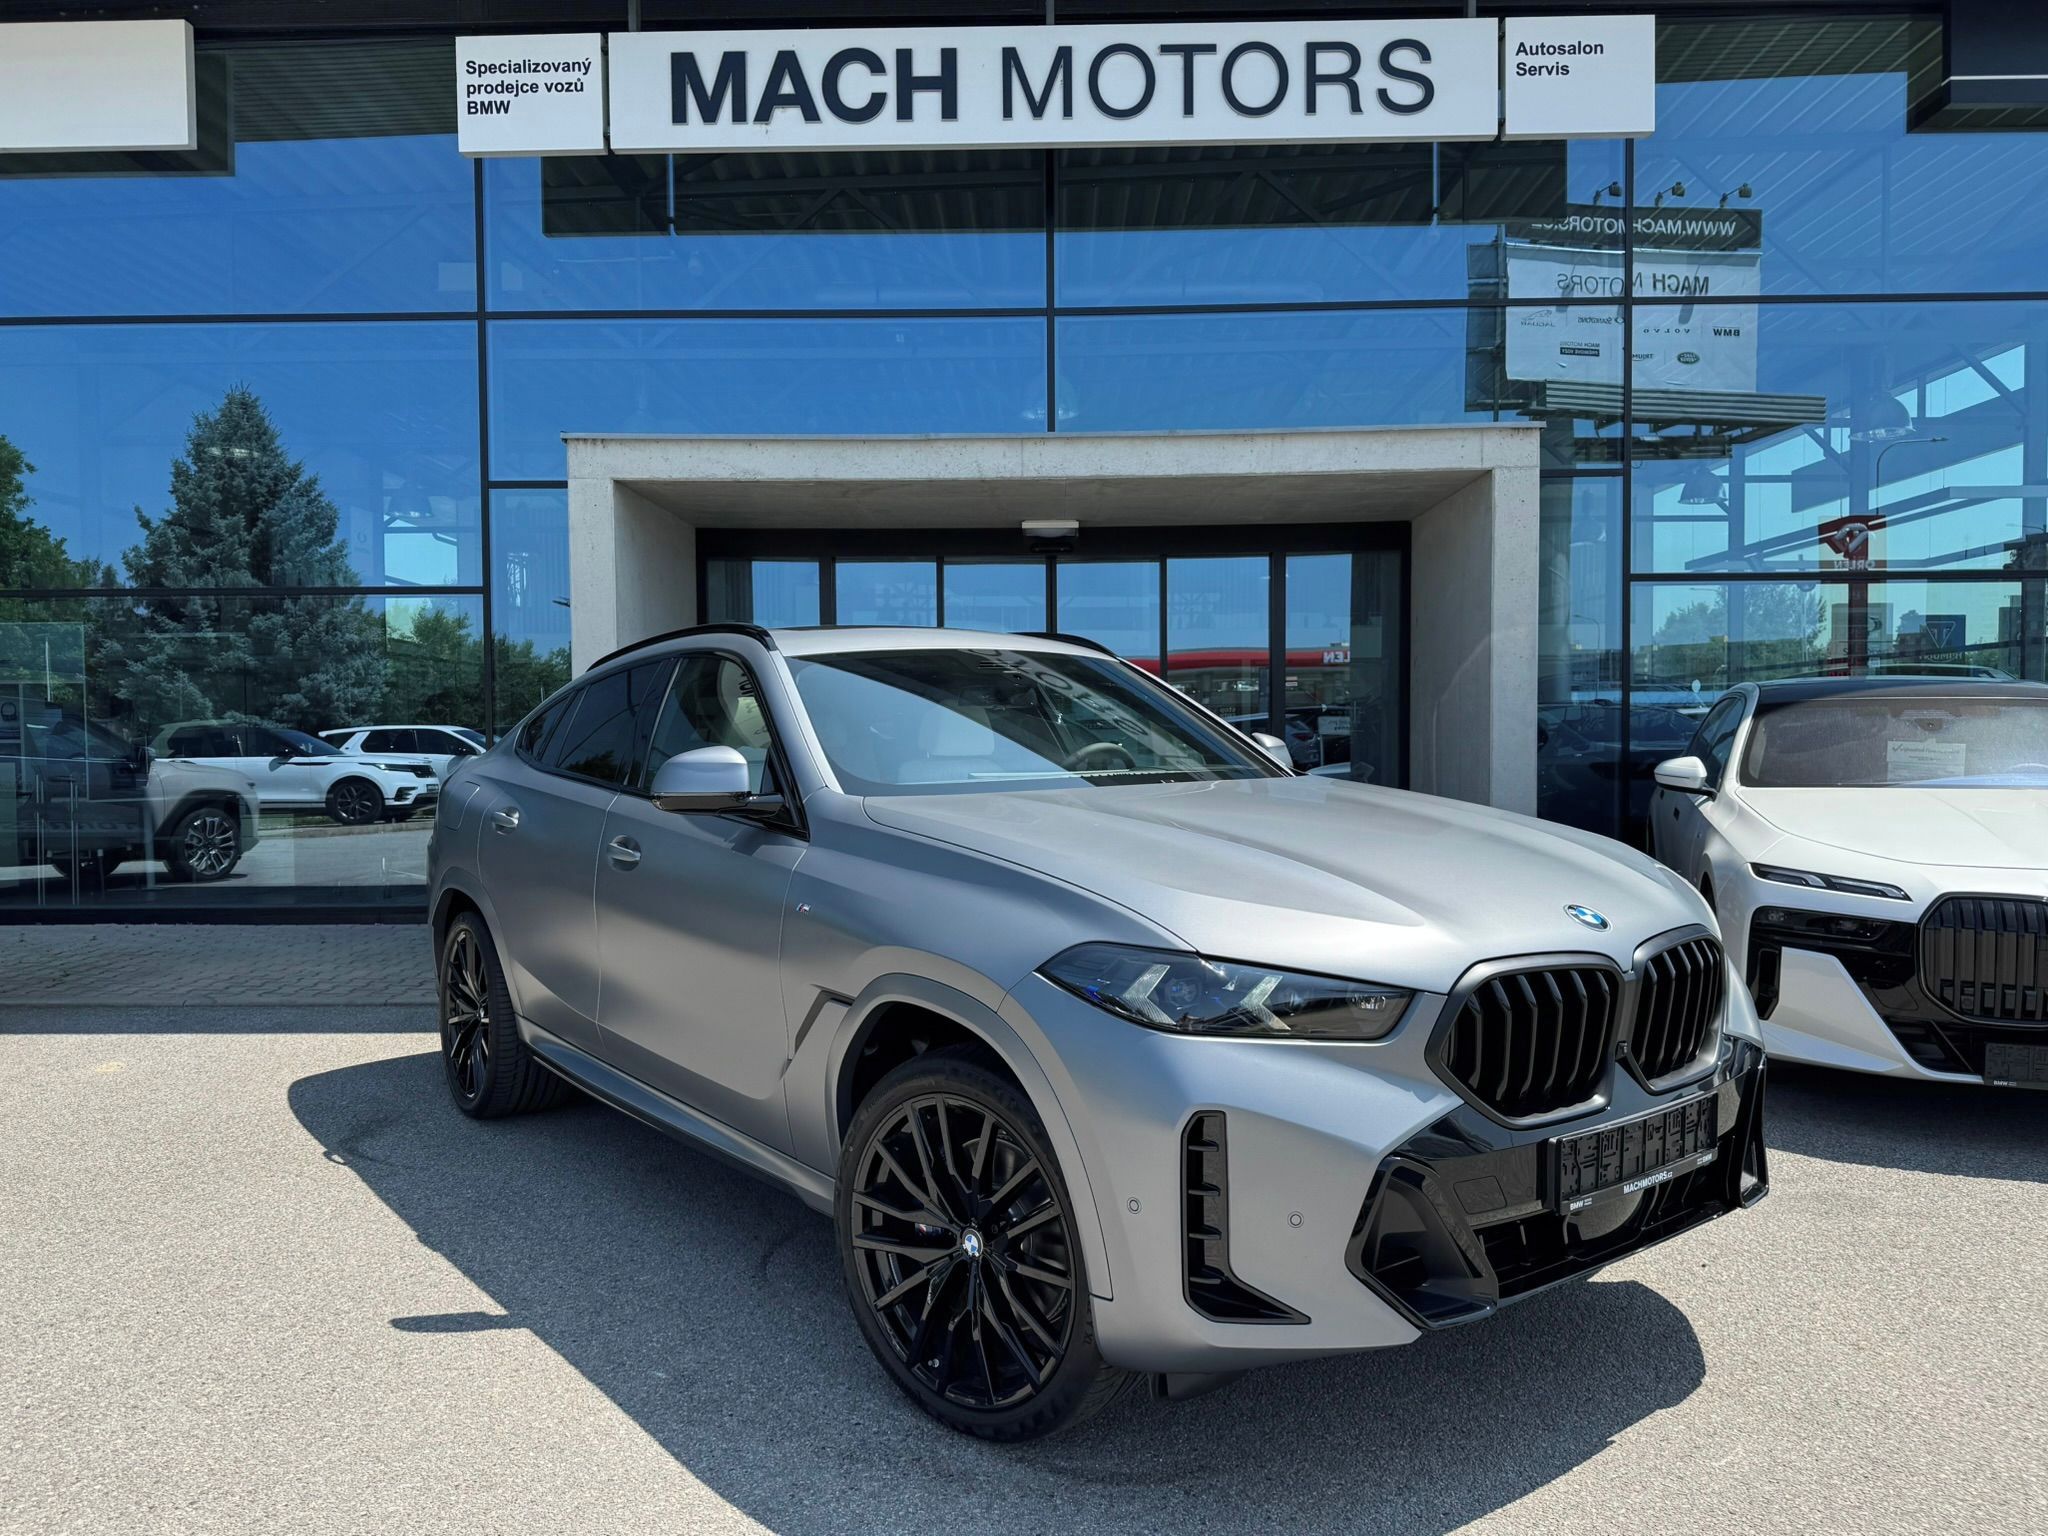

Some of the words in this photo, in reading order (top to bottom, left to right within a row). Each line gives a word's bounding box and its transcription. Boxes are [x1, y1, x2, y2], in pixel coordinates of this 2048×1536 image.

[1515, 40, 1604, 56] Autosalon
[465, 57, 592, 78] Specializovaný
[1515, 61, 1570, 77] Servis
[466, 79, 539, 98] prodejce
[543, 77, 585, 93] vozů
[670, 47, 959, 125] MACH
[1001, 38, 1436, 121] MOTORS
[467, 99, 511, 115] BMW
